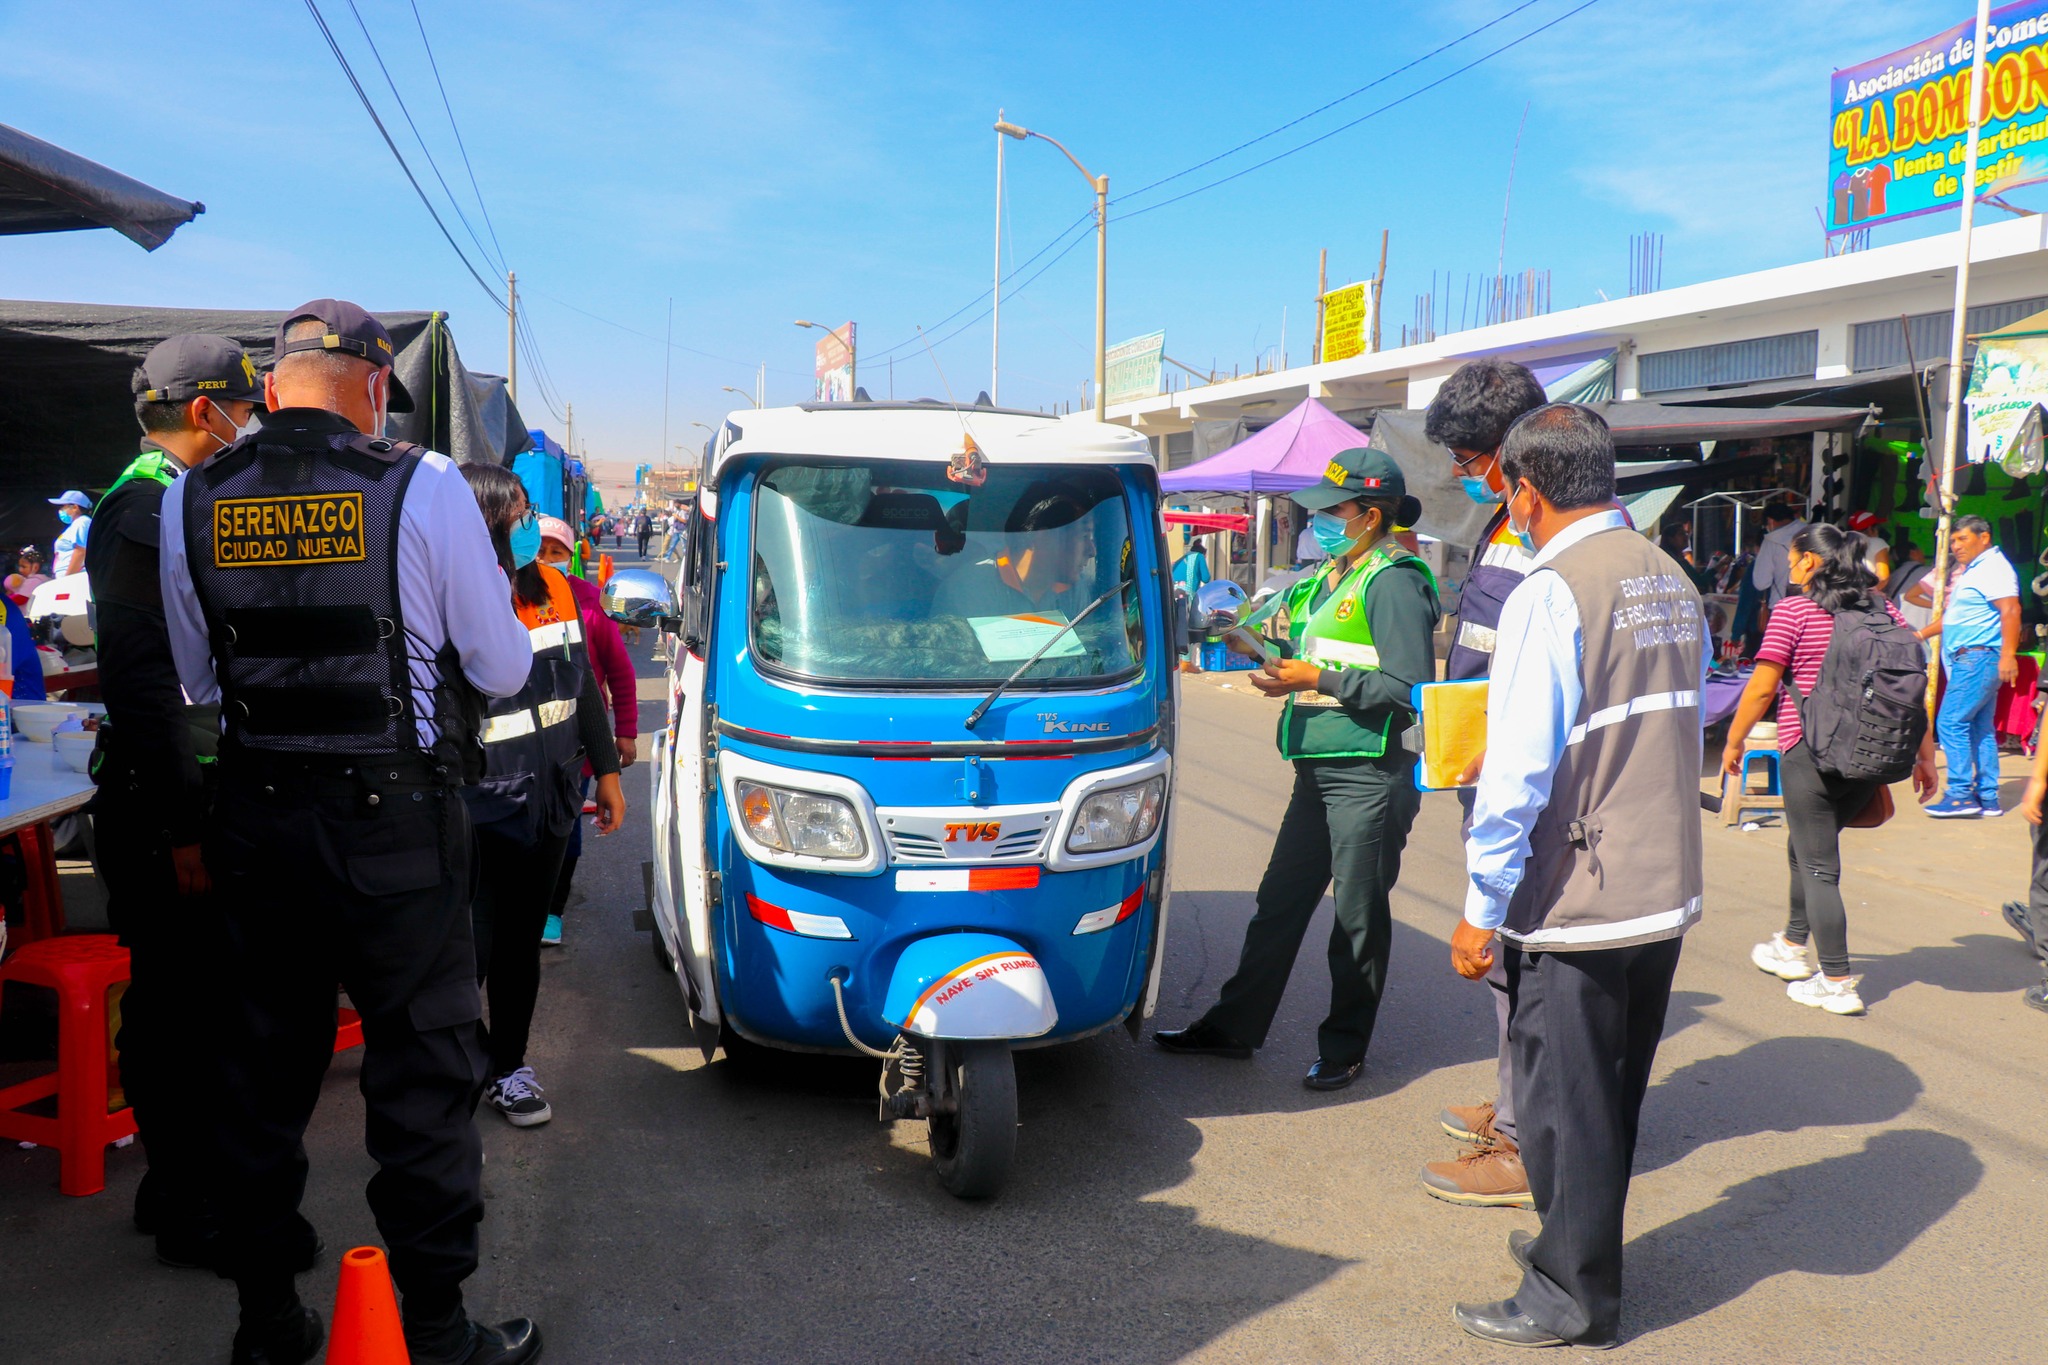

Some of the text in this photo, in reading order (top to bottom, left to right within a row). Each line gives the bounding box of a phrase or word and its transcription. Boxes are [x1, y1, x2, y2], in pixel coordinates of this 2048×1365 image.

[1844, 50, 1945, 105] Asociación
[1949, 37, 1974, 67] de
[1893, 151, 1945, 181] Venta
[1933, 152, 2025, 198] de estir
[197, 380, 228, 390] PERU
[219, 500, 357, 538] SERENAZGO
[219, 536, 359, 561] CIUDAD NUEVA
[1612, 610, 1628, 630] DE
[1036, 712, 1058, 721] TVS
[944, 821, 1002, 843] TVS
[935, 959, 1041, 1006] NAVE SIN RUMBO
